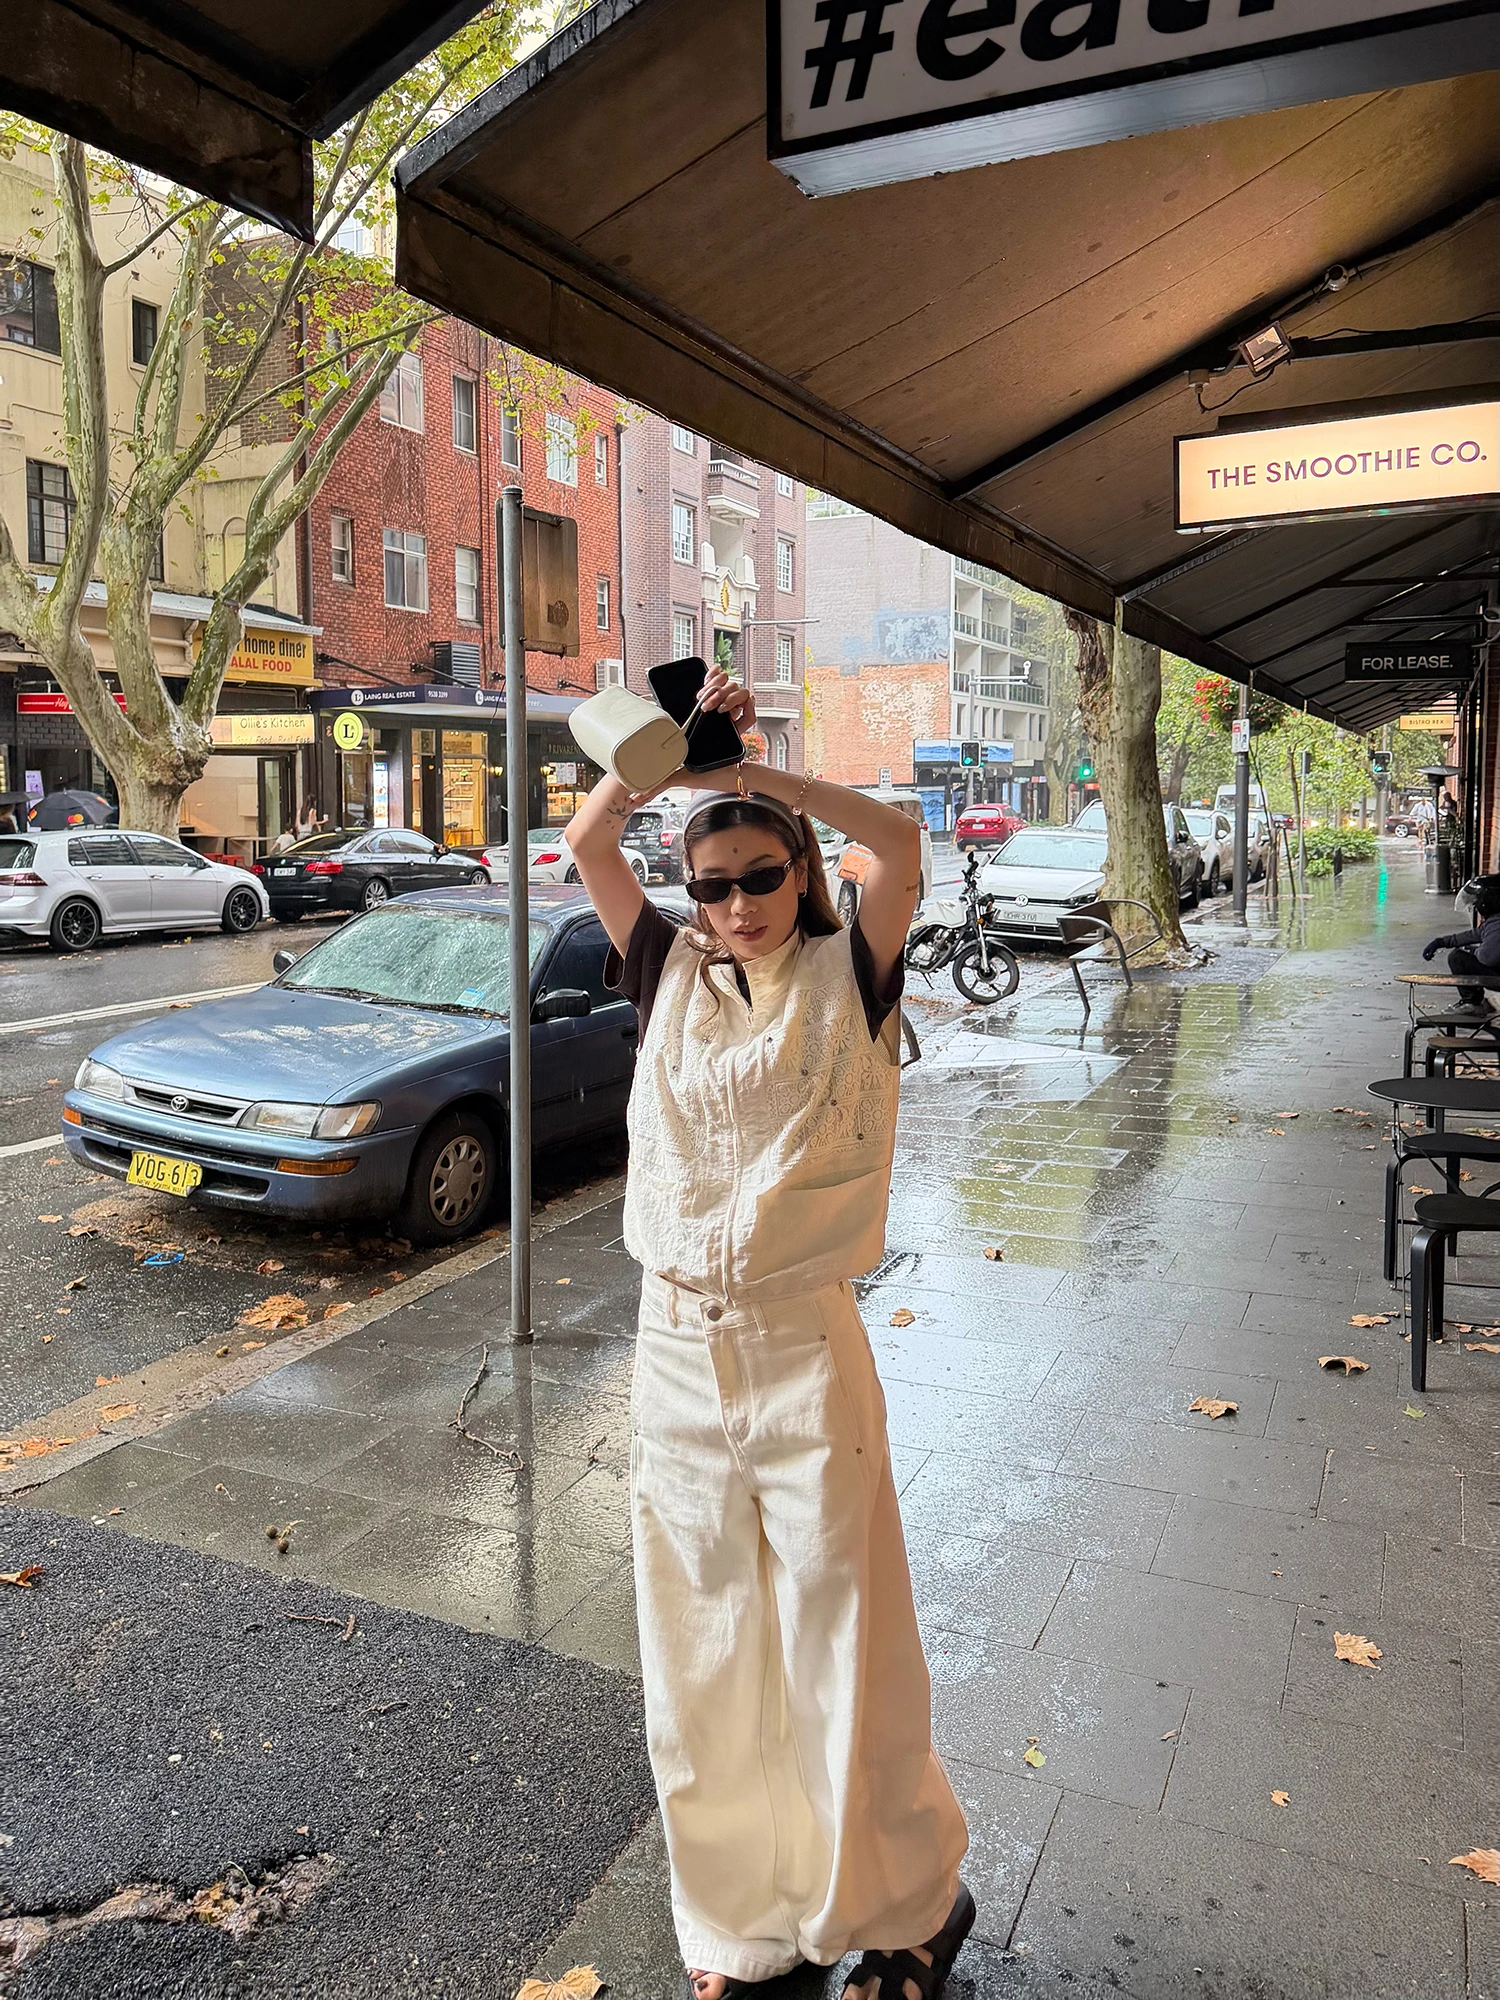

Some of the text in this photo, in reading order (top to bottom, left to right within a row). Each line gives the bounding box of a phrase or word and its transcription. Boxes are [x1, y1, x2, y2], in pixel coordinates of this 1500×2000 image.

[1207, 440, 1488, 489] THE SMOOTHIE CO.
[244, 634, 276, 656] home
[279, 638, 307, 659] diner
[262, 659, 292, 672] FOOD
[1361, 655, 1454, 671] FOR LEASE.
[270, 716, 306, 728] Kitchen
